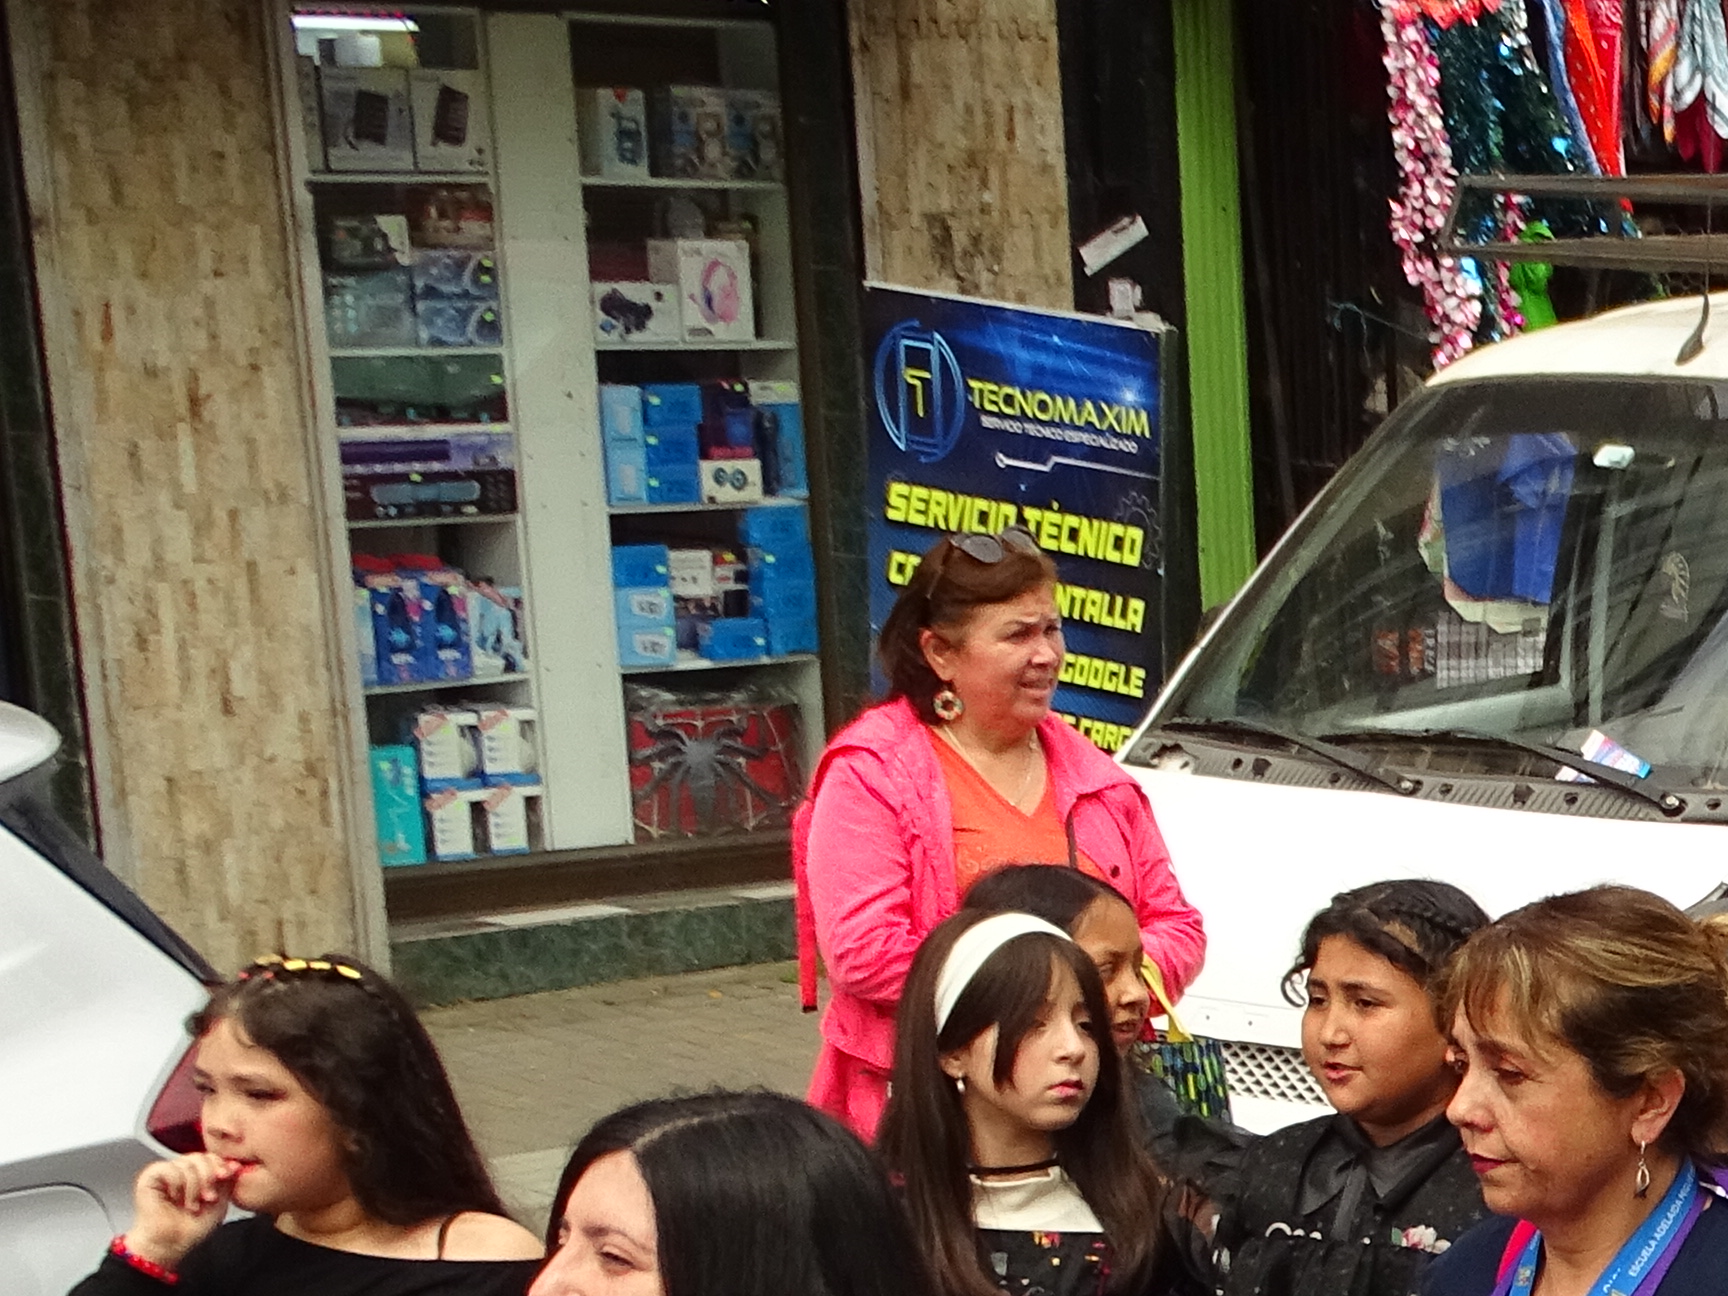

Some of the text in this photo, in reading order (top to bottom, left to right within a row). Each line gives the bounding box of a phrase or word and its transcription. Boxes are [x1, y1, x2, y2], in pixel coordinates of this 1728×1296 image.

[966, 378, 1151, 440] TECNOMAXIM
[885, 481, 1145, 568] SERVICIO TÉCNICO
[1053, 580, 1146, 634] NTALLA
[1056, 652, 1147, 699] GOOGLE
